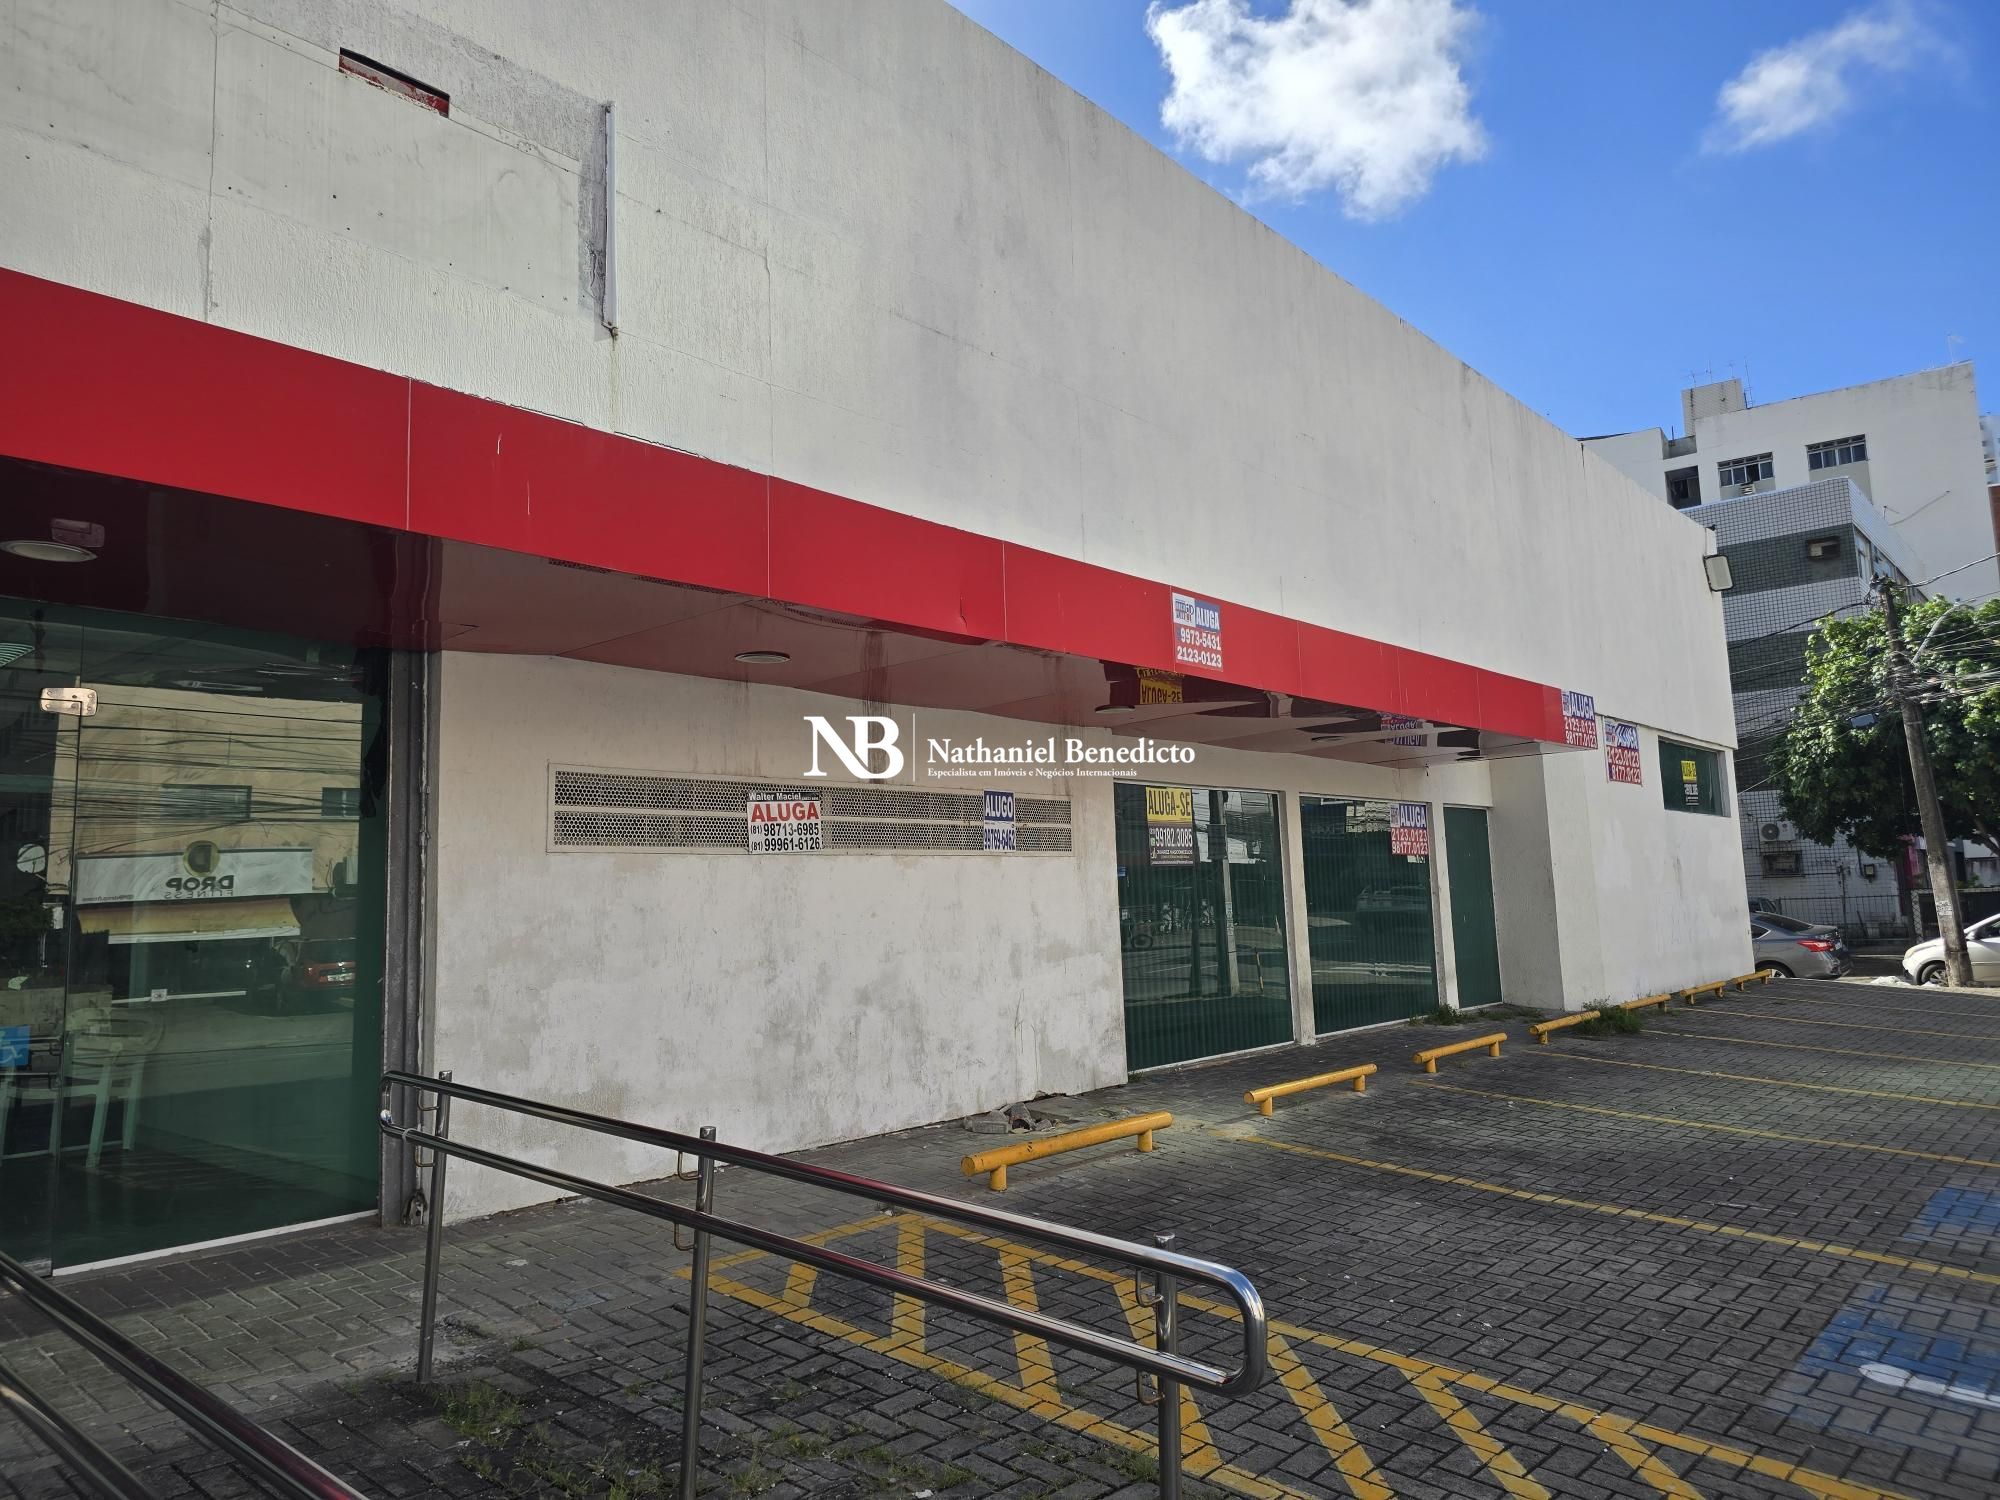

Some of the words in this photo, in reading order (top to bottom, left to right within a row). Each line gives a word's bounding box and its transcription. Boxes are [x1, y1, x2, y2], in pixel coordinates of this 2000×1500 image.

[1195, 607, 1220, 630] ALUGA
[1180, 627, 1222, 651] 9973-5431
[1177, 645, 1222, 667] 2123-0123
[1570, 692, 1595, 720] ALUGA
[1616, 724, 1638, 750] ALUGA
[748, 792, 774, 801] Walter
[776, 792, 801, 801] Maciel
[985, 795, 1014, 818] ALUGO
[1148, 789, 1191, 816] ALUGA-SE
[751, 802, 819, 822] ALUGA
[1400, 805, 1427, 828] ALUGA
[750, 825, 763, 834] (81)
[763, 823, 820, 836] 98713-6985
[1155, 828, 1193, 847] 99182.3085
[1391, 828, 1428, 842] 2123.0123
[764, 837, 820, 851] 99961-6126
[1392, 841, 1429, 855] 98177.0123
